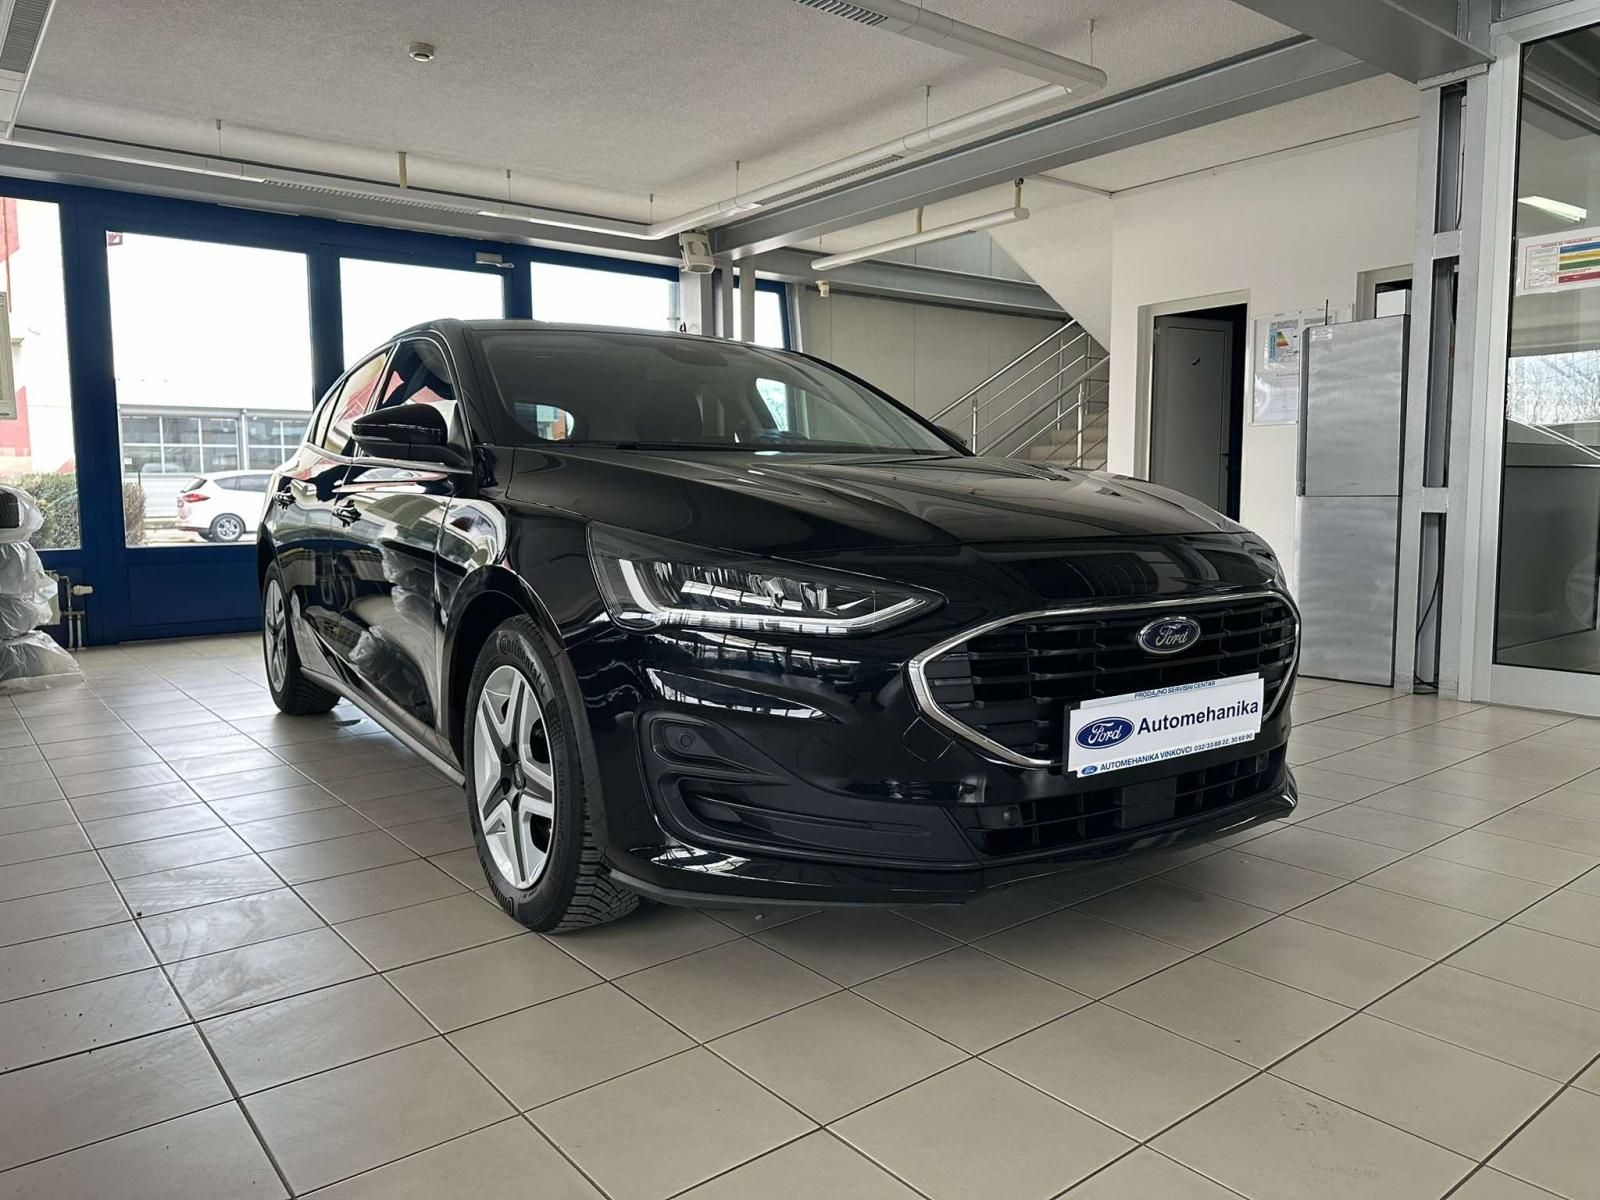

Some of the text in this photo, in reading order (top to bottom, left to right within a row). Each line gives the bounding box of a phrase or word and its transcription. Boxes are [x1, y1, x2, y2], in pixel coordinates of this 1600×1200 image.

[1155, 624, 1190, 647] Ford
[499, 634, 542, 686] Continental
[1193, 681, 1216, 689] CENTAR
[1087, 700, 1259, 745] Ford Automehanika
[1100, 753, 1159, 771] AUTOMEHANIKA
